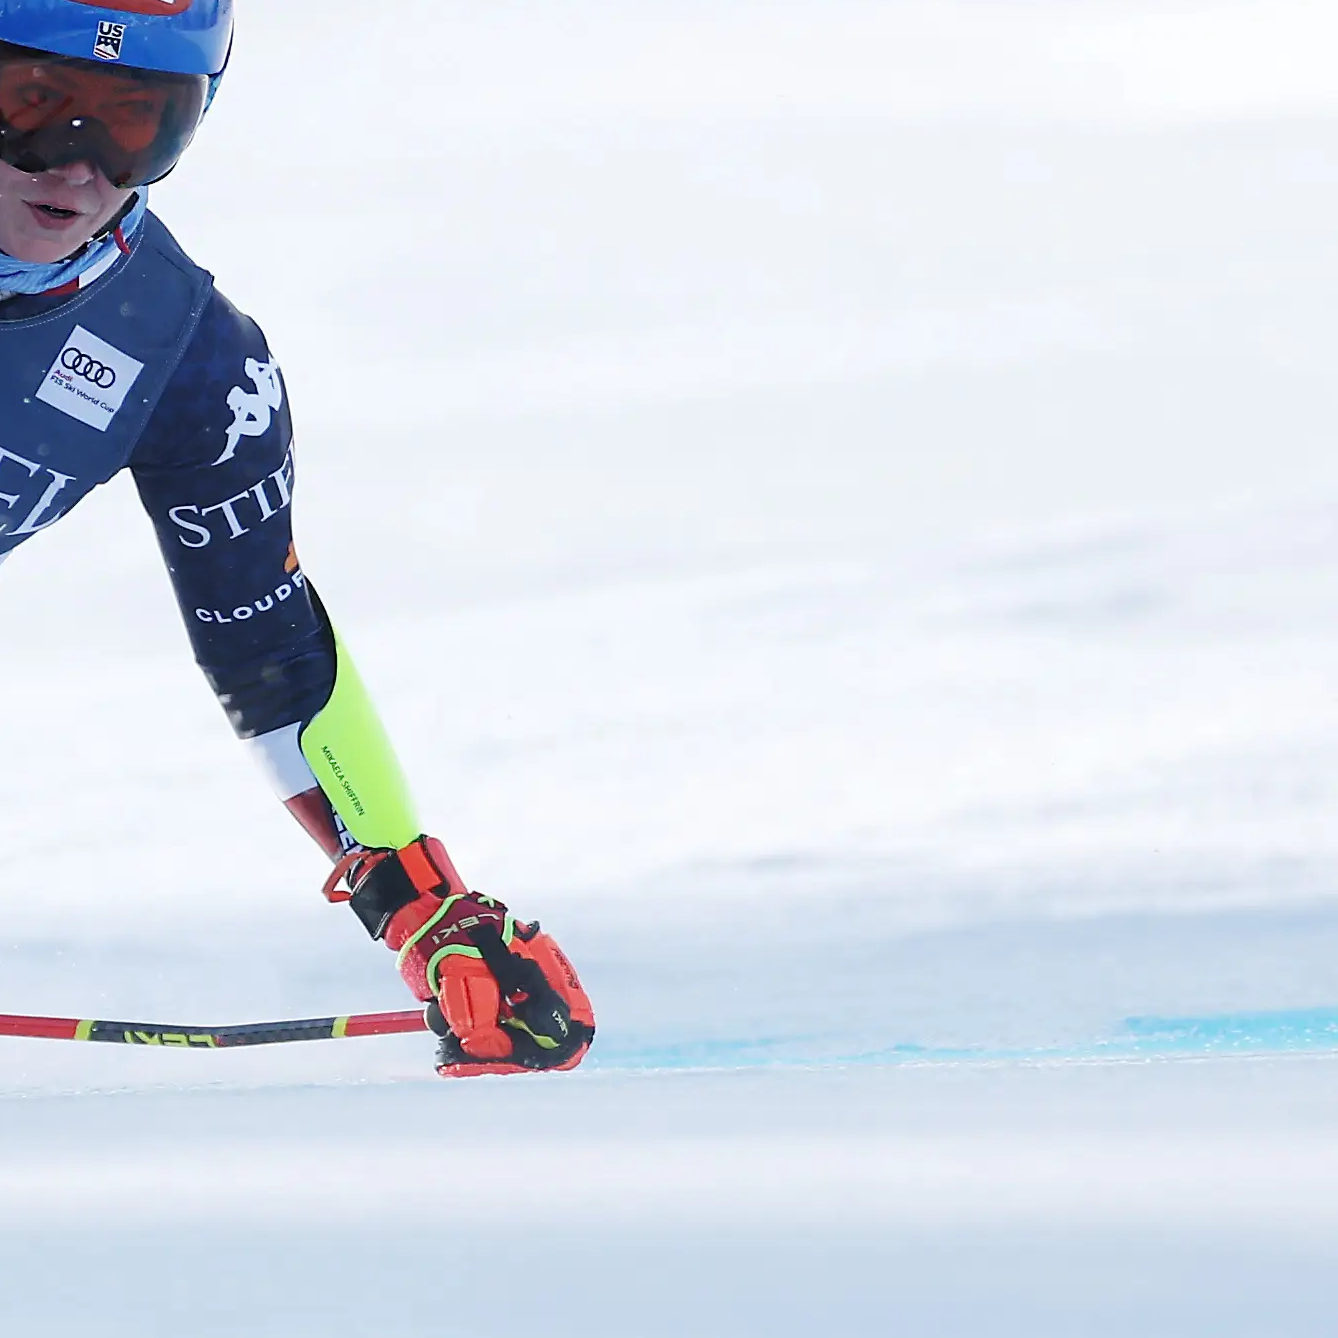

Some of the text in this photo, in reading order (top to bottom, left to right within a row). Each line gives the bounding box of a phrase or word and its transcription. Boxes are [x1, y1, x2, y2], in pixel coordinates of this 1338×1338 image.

[99, 21, 123, 37] US
[54, 369, 74, 383] Audi
[50, 375, 115, 413] FIS Ski World Cup
[321, 745, 345, 782] MIKAELA
[342, 780, 365, 817] SHIFFRIN
[431, 913, 500, 945] LEKI
